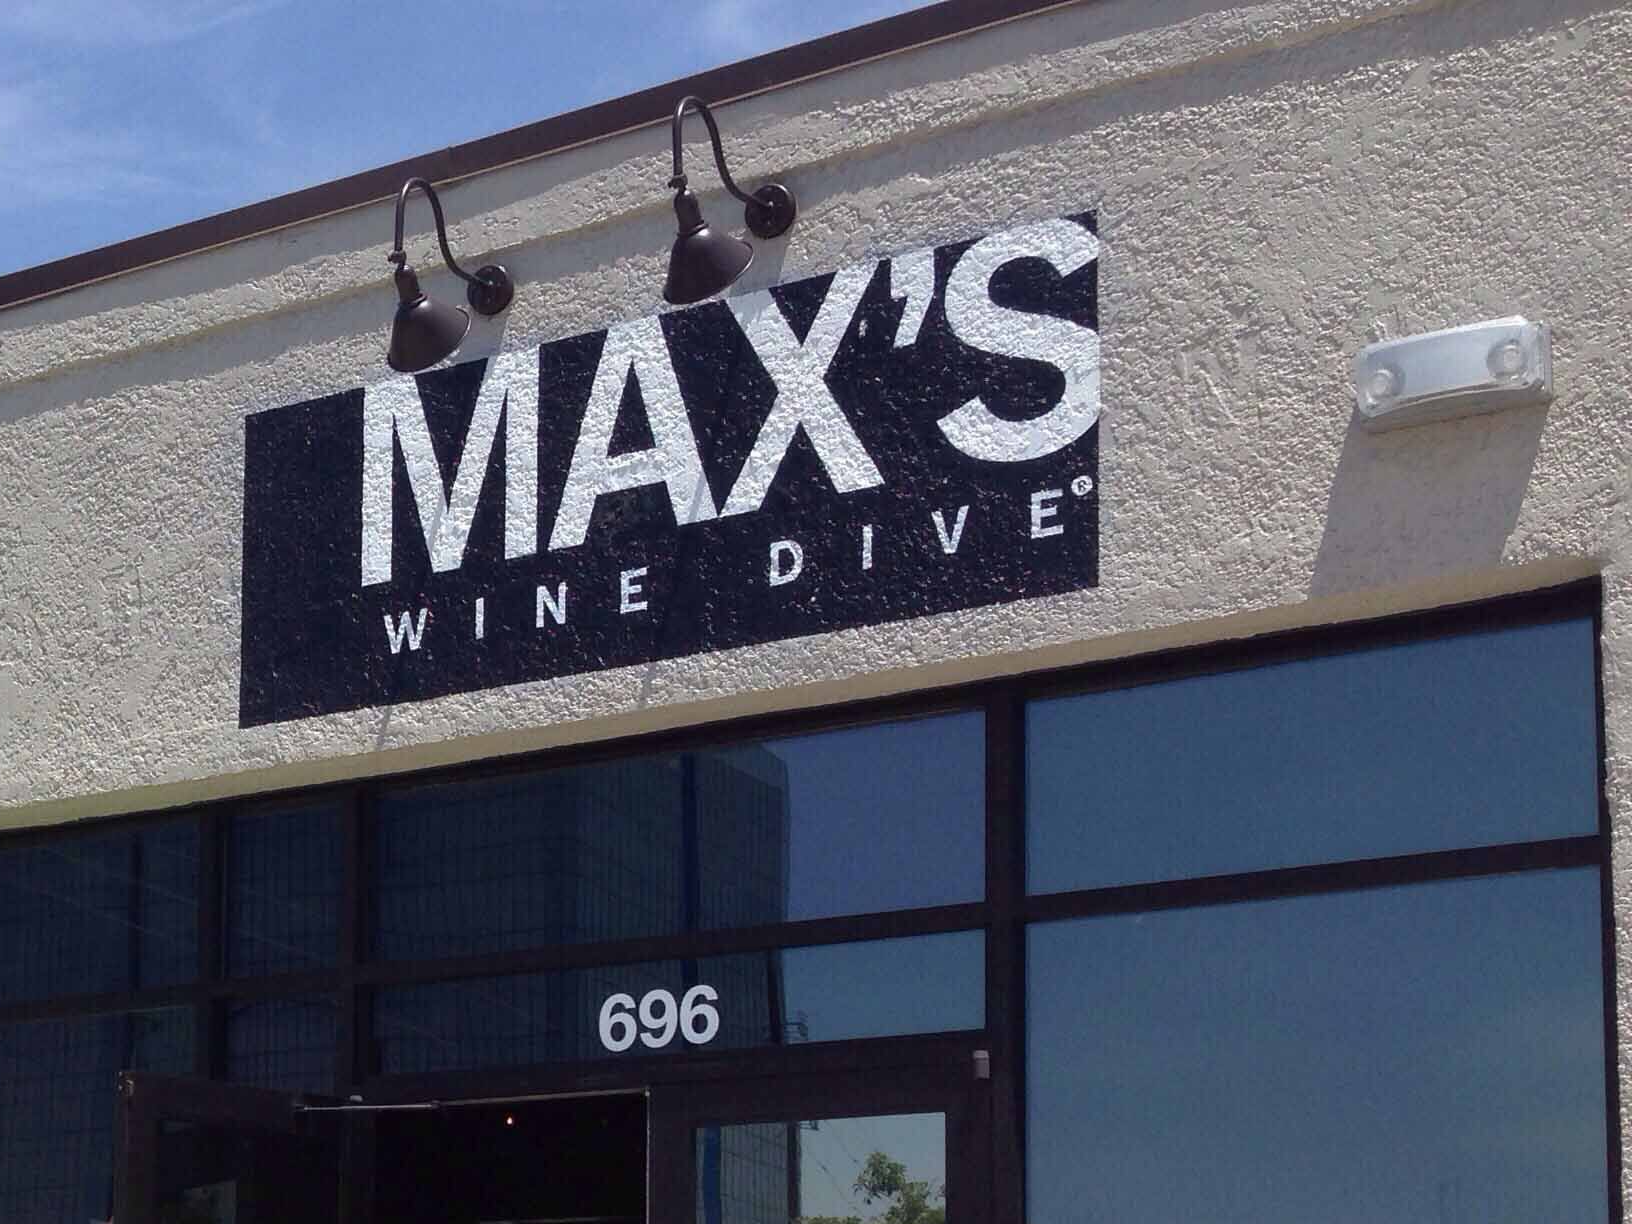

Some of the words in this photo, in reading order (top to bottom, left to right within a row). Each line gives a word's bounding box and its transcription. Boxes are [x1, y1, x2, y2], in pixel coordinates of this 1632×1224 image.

[361, 217, 1100, 587] MAX'S
[384, 567, 649, 654] WINE
[599, 984, 720, 1053] 696
